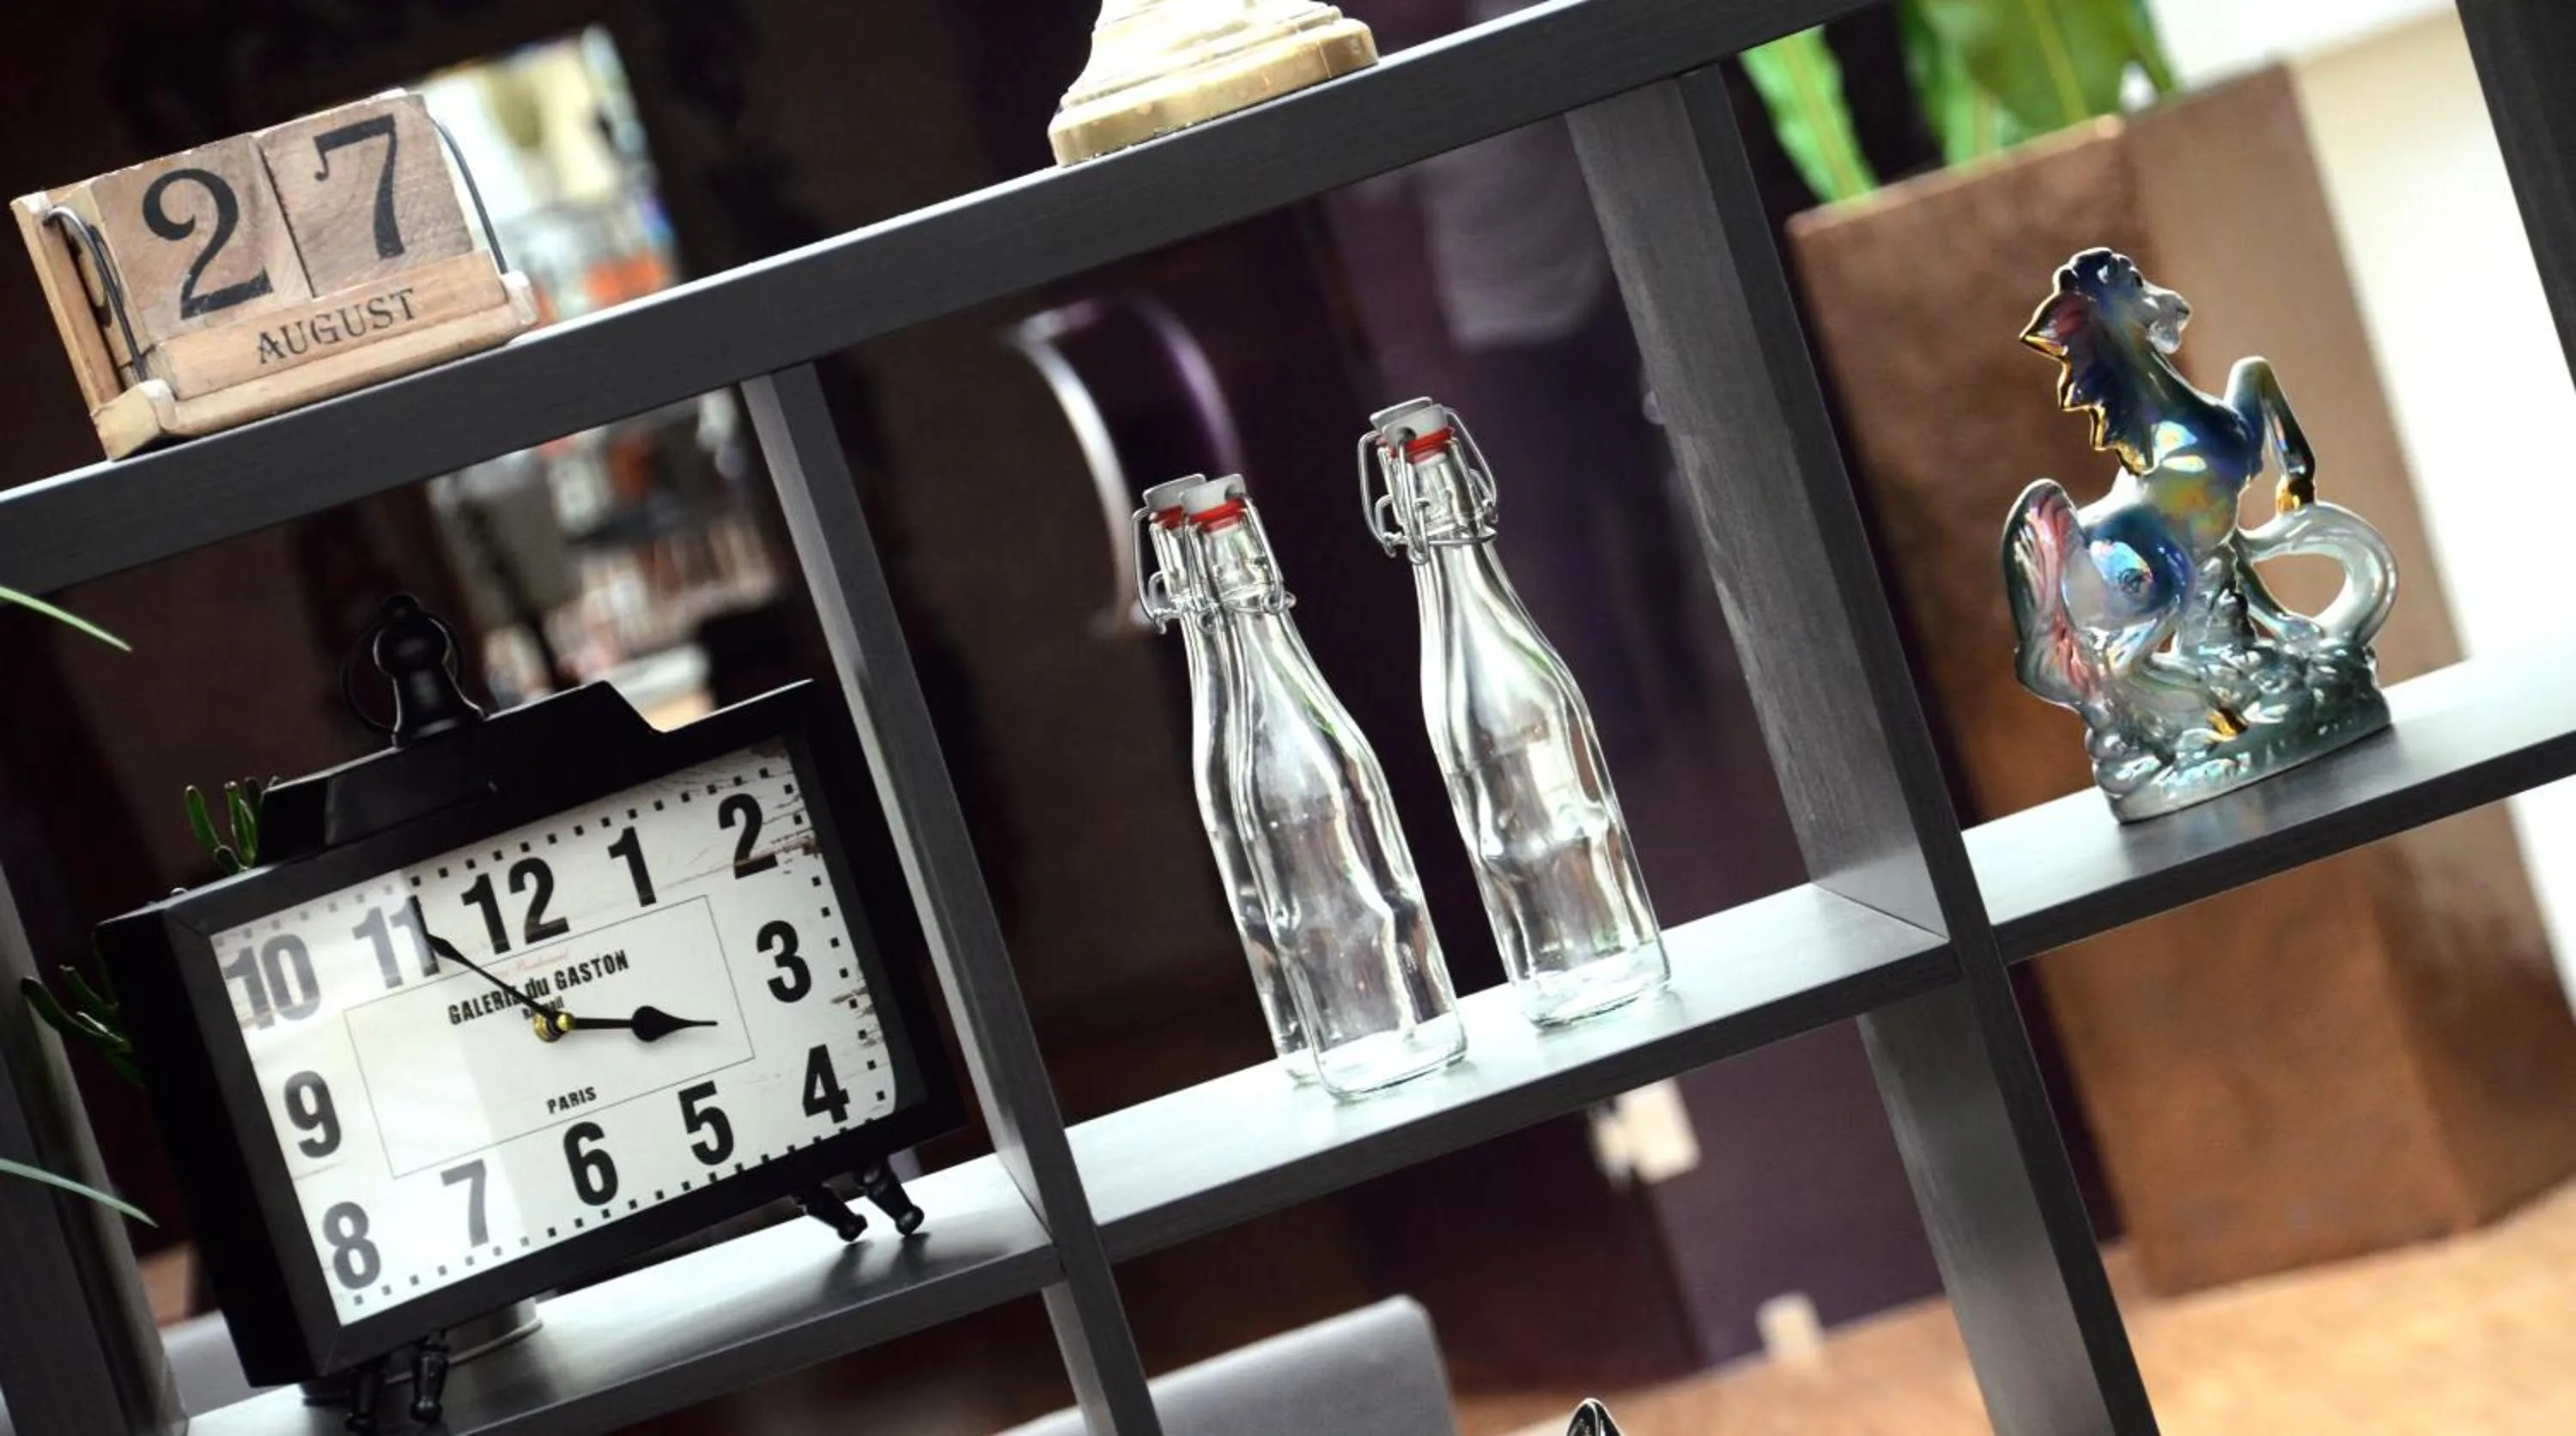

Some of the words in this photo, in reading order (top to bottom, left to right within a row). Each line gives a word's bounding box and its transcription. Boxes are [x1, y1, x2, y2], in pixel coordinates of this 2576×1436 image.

[258, 288, 417, 365] AUGUST
[607, 825, 657, 908] 1
[717, 793, 778, 880] 2
[351, 895, 440, 989] 11
[461, 857, 570, 955] 12
[223, 933, 322, 1031] 10
[525, 976, 550, 999] du
[554, 949, 629, 991] GASTON
[756, 920, 812, 1003] 3
[283, 1070, 343, 1159] 9
[546, 1086, 598, 1115] PARIS
[677, 1080, 735, 1166] 5
[802, 1044, 850, 1124] 4
[440, 1158, 490, 1248] 7
[562, 1121, 619, 1207] 6
[322, 1200, 382, 1290] 8
